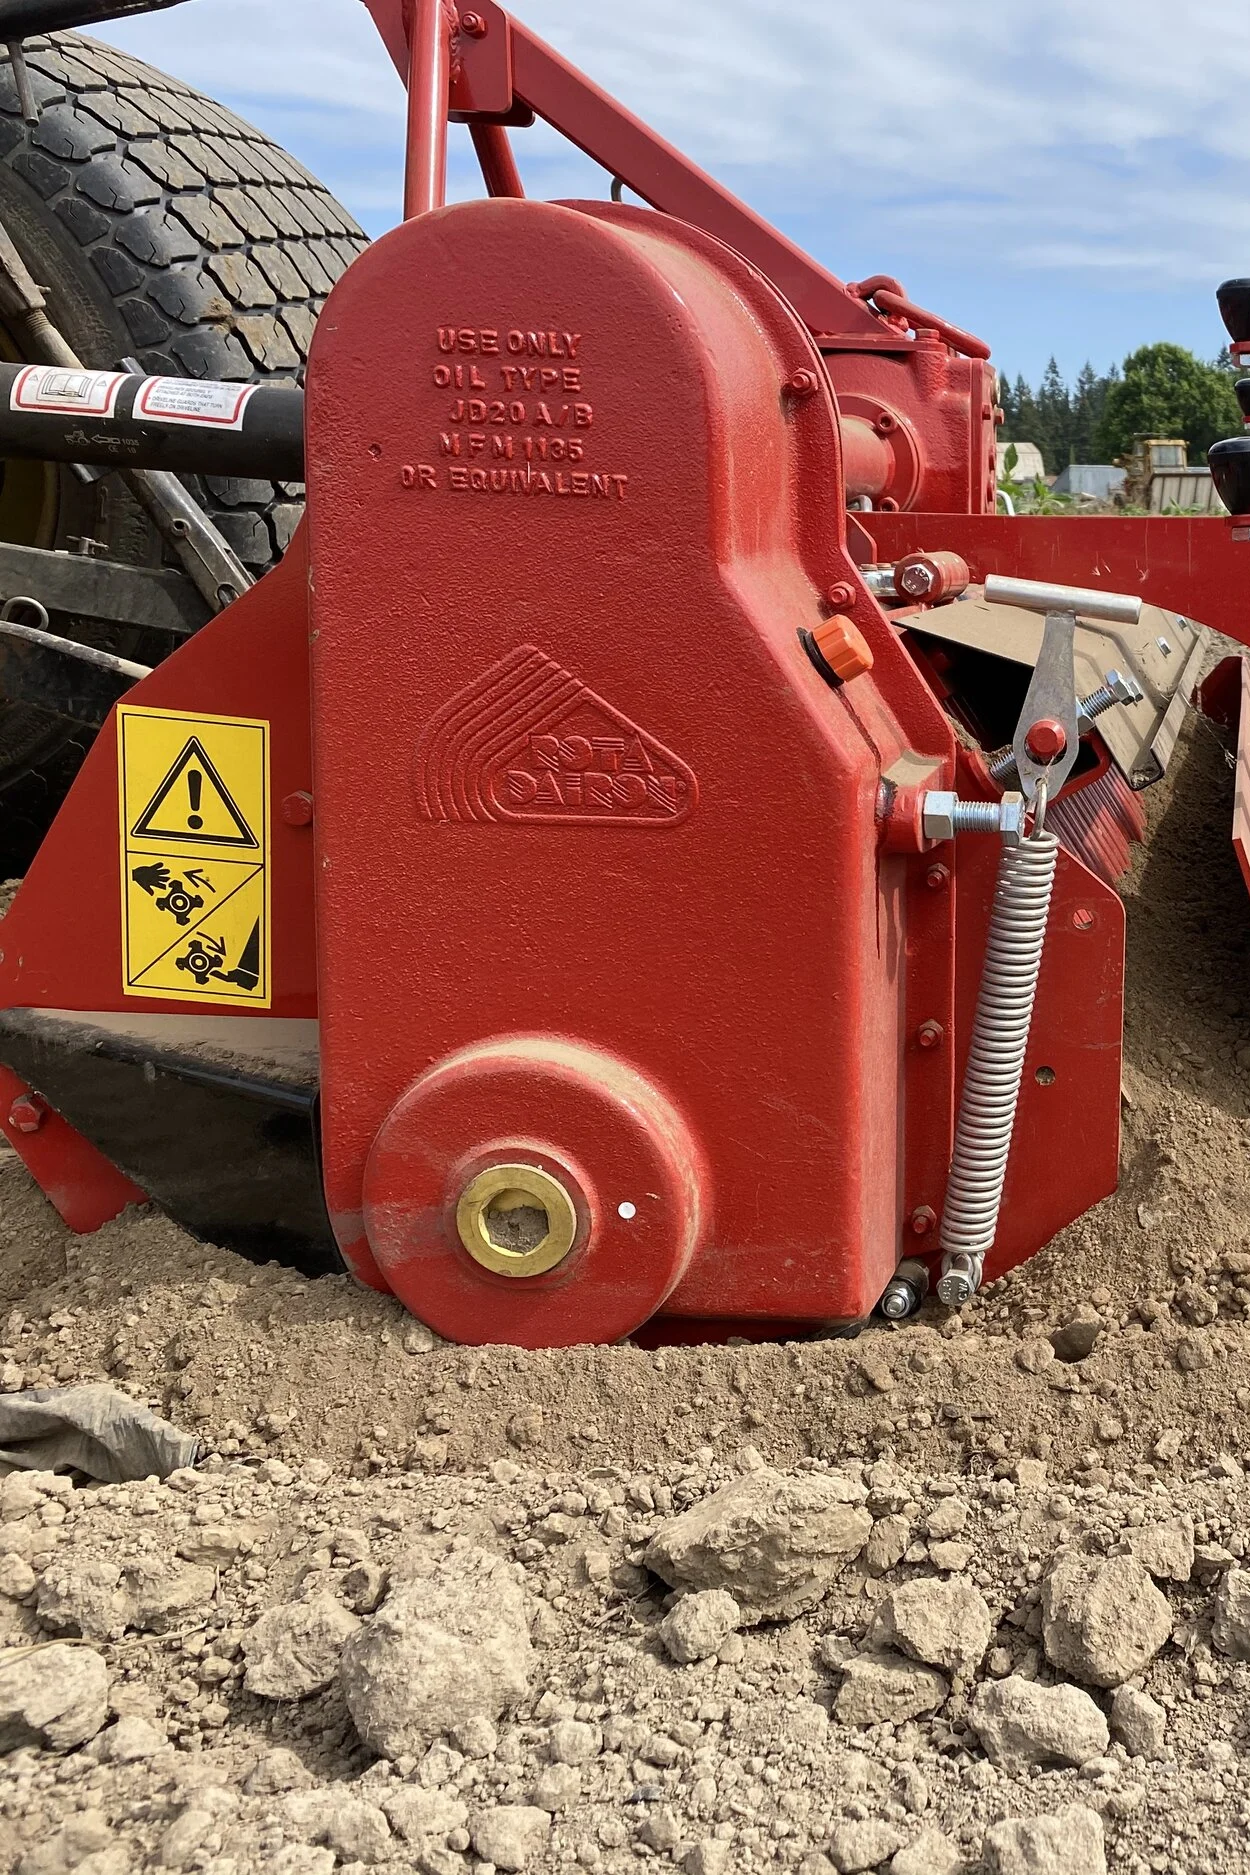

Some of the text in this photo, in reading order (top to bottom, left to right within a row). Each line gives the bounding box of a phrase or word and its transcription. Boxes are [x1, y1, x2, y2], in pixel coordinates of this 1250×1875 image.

[437, 327, 582, 359] USE ONLY
[432, 364, 581, 393] OIL TYPE
[176, 404, 201, 412] DRIVELINE
[450, 399, 594, 428] JD20 A/B
[523, 436, 584, 462] 1135
[401, 464, 628, 500] OR EQUIVALENT
[528, 734, 654, 773] ROTA
[507, 769, 678, 814] DAIRON
